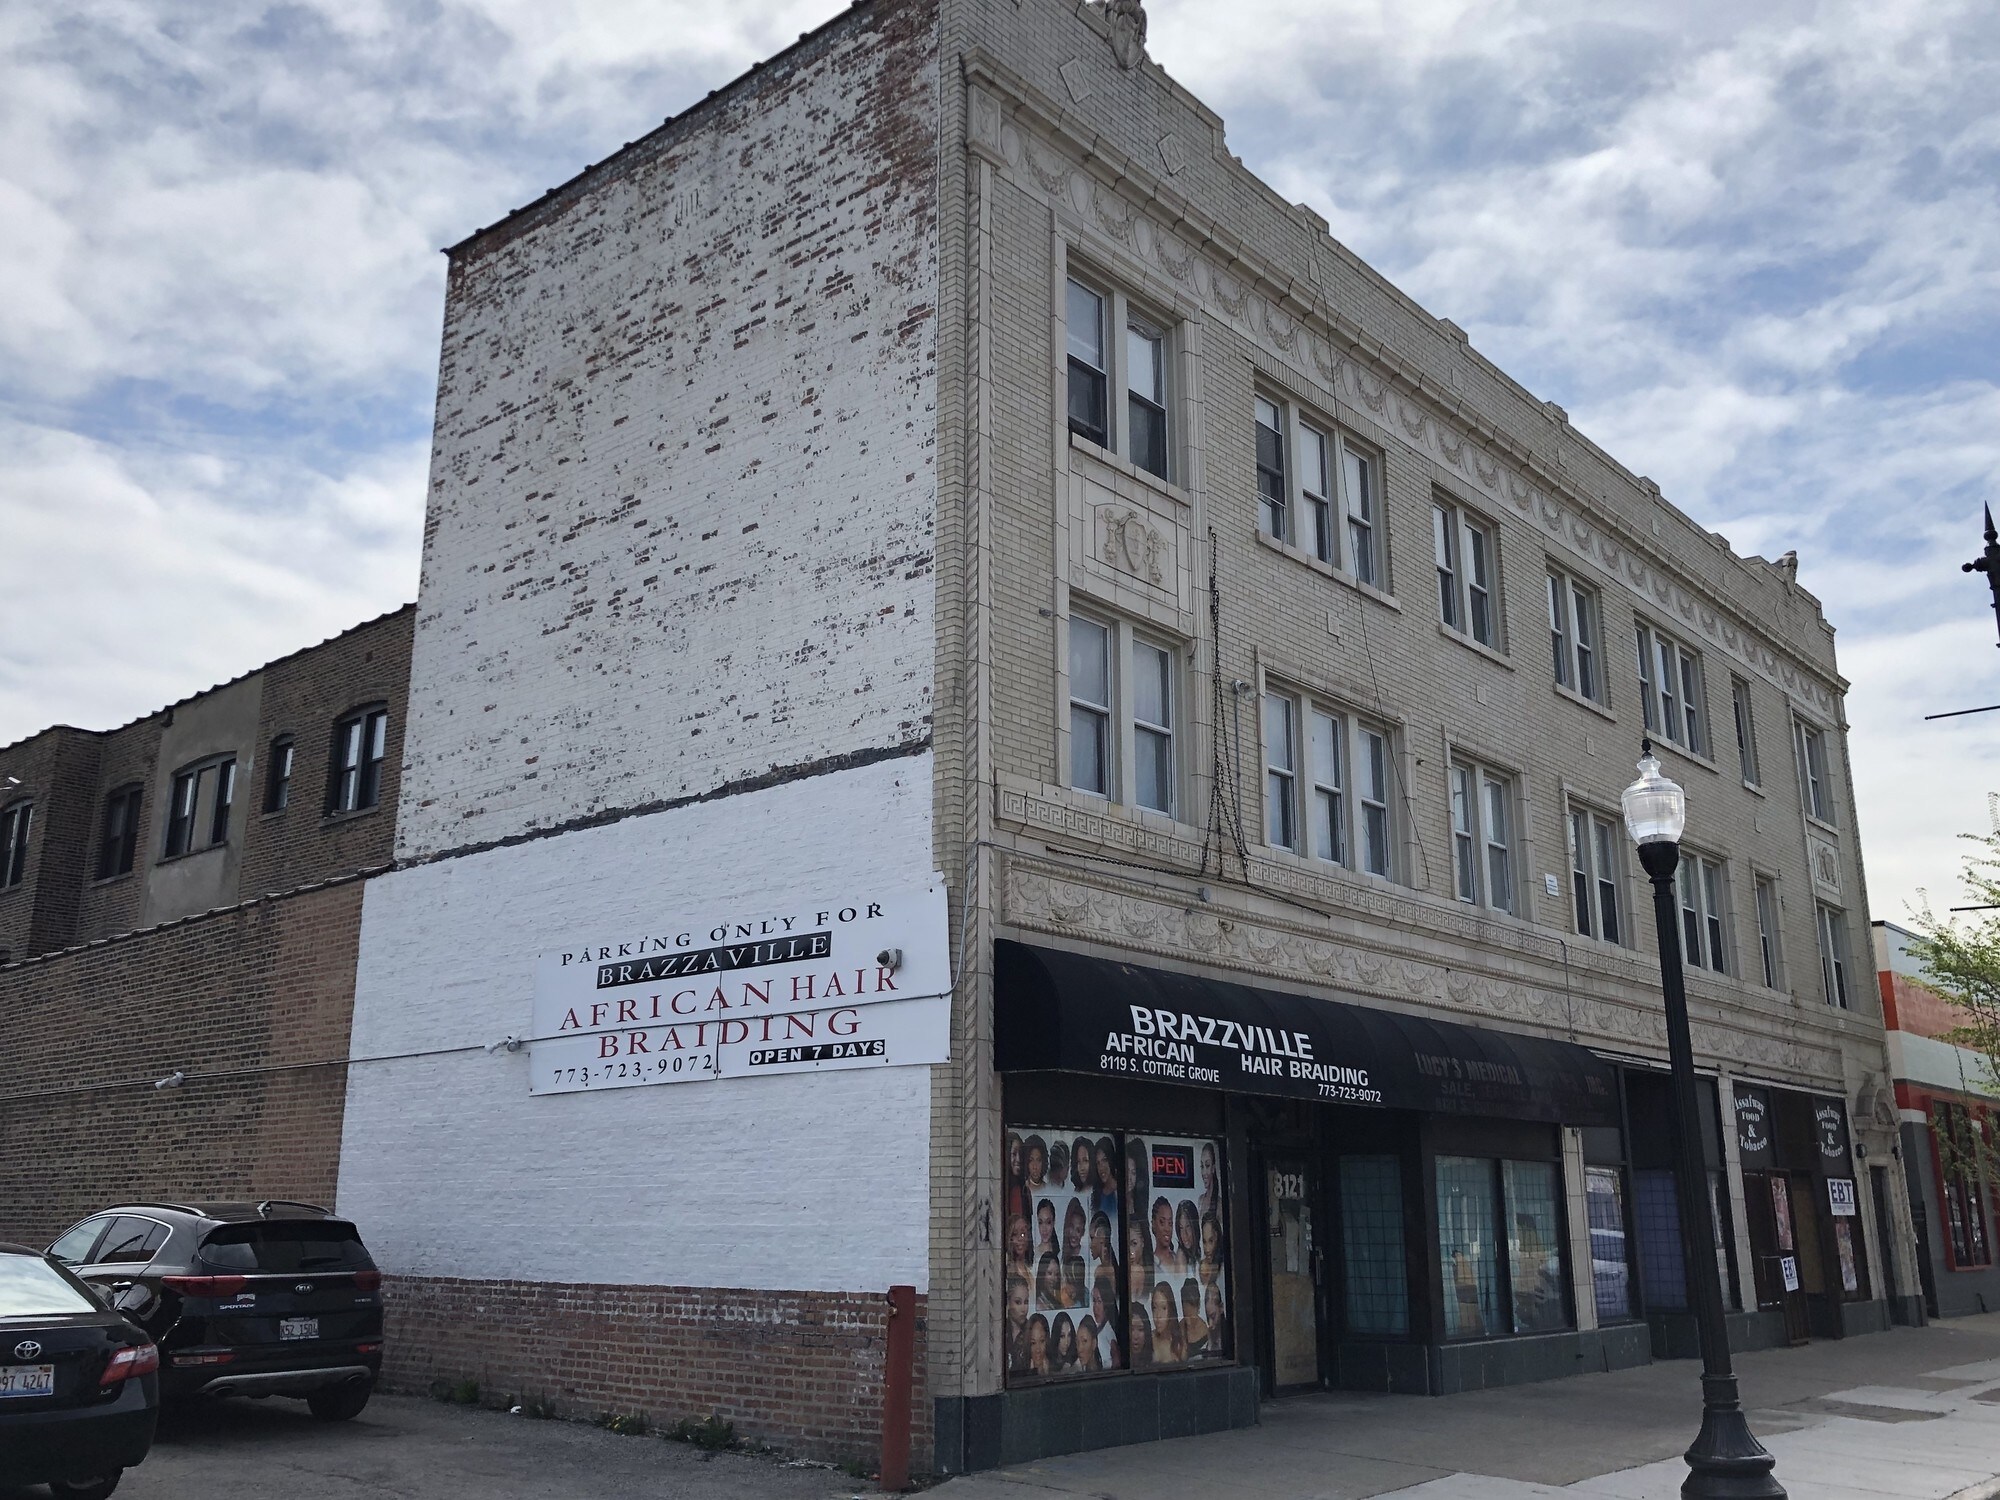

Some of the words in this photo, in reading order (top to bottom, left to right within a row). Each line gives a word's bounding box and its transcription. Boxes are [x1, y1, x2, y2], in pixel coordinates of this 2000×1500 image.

[561, 933, 691, 966] PARKING
[709, 916, 797, 941] ONLY
[816, 903, 884, 926] FOR
[599, 936, 828, 985] BRAZZAVILLE
[559, 980, 774, 1030] AFRICAN
[790, 967, 899, 1001] HAIR
[597, 1009, 862, 1058] BRAIDING
[1130, 1004, 1314, 1060] BRAZZVILLE
[750, 1048, 802, 1064] OPEN
[813, 1046, 823, 1059] 7
[832, 1041, 885, 1057] DAYS
[1105, 1031, 1195, 1063] AFRICAN
[554, 1054, 713, 1083] 773-723-9072
[1100, 1054, 1127, 1071] 8119
[1130, 1058, 1139, 1072] S.
[1143, 1059, 1186, 1078] COTTAGE
[1188, 1066, 1220, 1083] GROVE
[1241, 1053, 1283, 1076] HAIR
[1290, 1060, 1369, 1086] BRAIDING
[1414, 1051, 1463, 1079] LUCY'S
[1465, 1059, 1523, 1085] MEDICAL
[1318, 1083, 1382, 1102] 773-723-9072
[1741, 1111, 1760, 1122] FOOD
[1747, 1123, 1757, 1138] &
[1821, 1120, 1838, 1131] FOOD
[1740, 1134, 1768, 1151] Tobacco
[1827, 1132, 1835, 1145] &
[1273, 1172, 1304, 1199] 8121
[1830, 1181, 1852, 1202] EBT
[0, 1375, 16, 1391] 97
[23, 1374, 51, 1390] 4247
